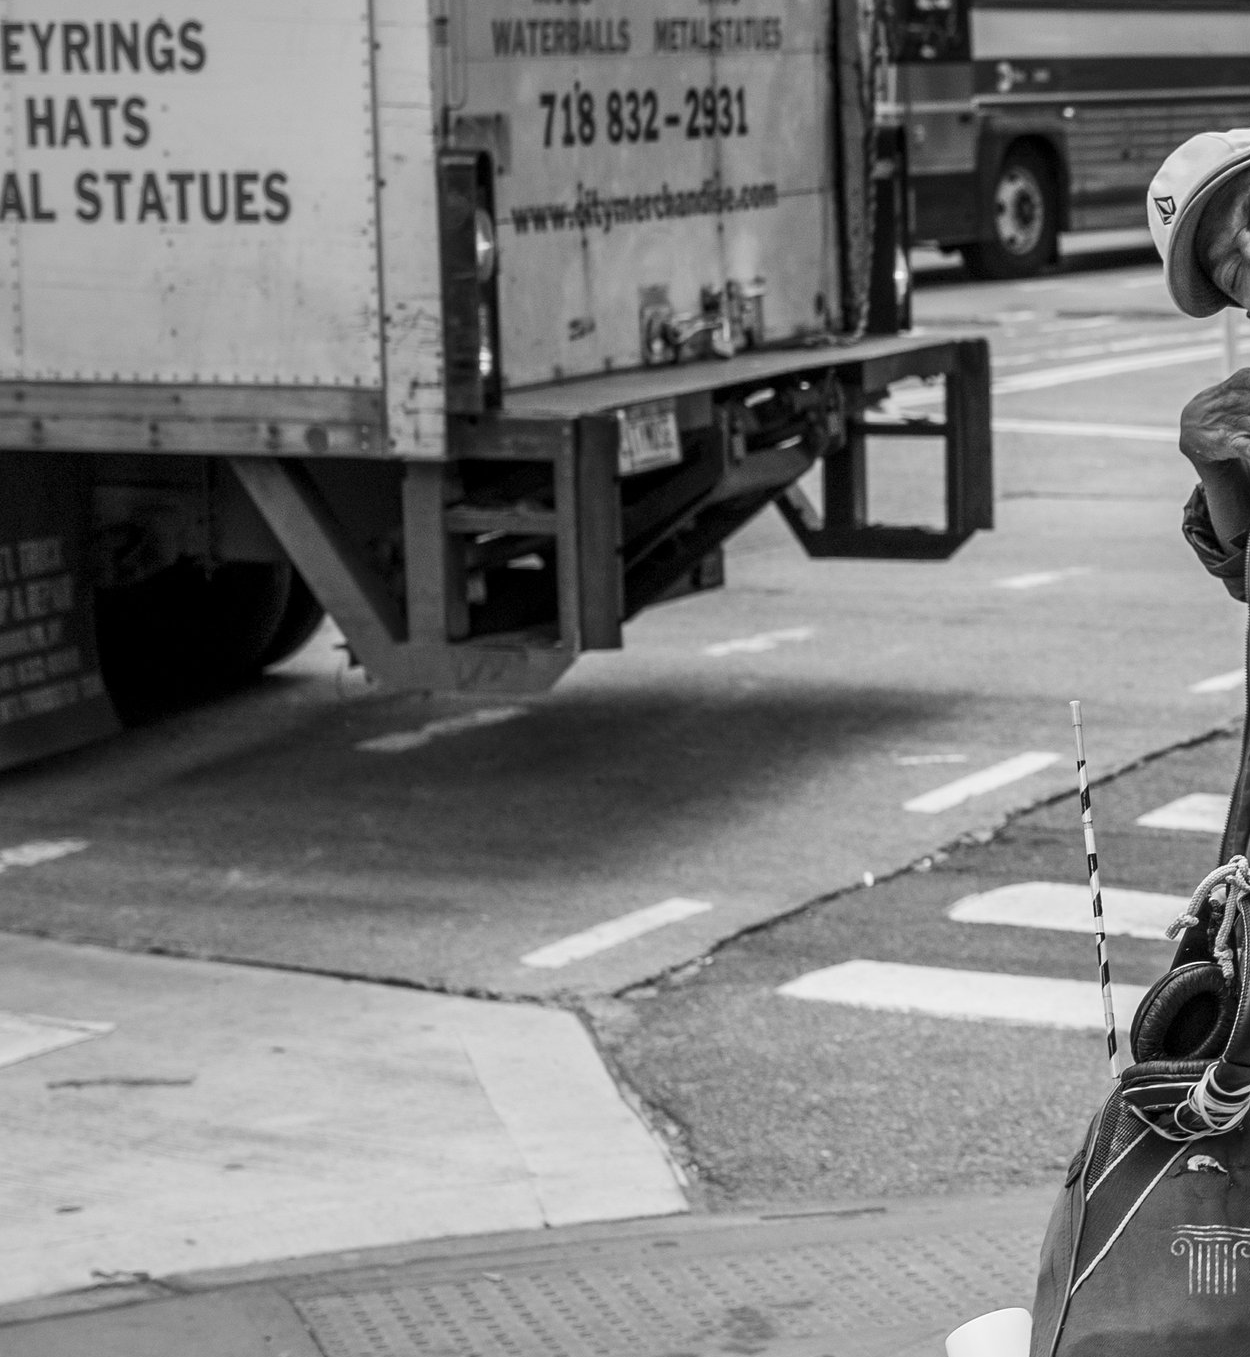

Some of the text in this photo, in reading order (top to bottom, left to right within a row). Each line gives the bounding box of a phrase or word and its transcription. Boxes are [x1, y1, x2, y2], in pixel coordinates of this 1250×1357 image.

[491, 17, 632, 57] WATERBALLS
[25, 96, 151, 149] HATS
[539, 90, 596, 148] 718
[74, 170, 292, 225] STATUES
